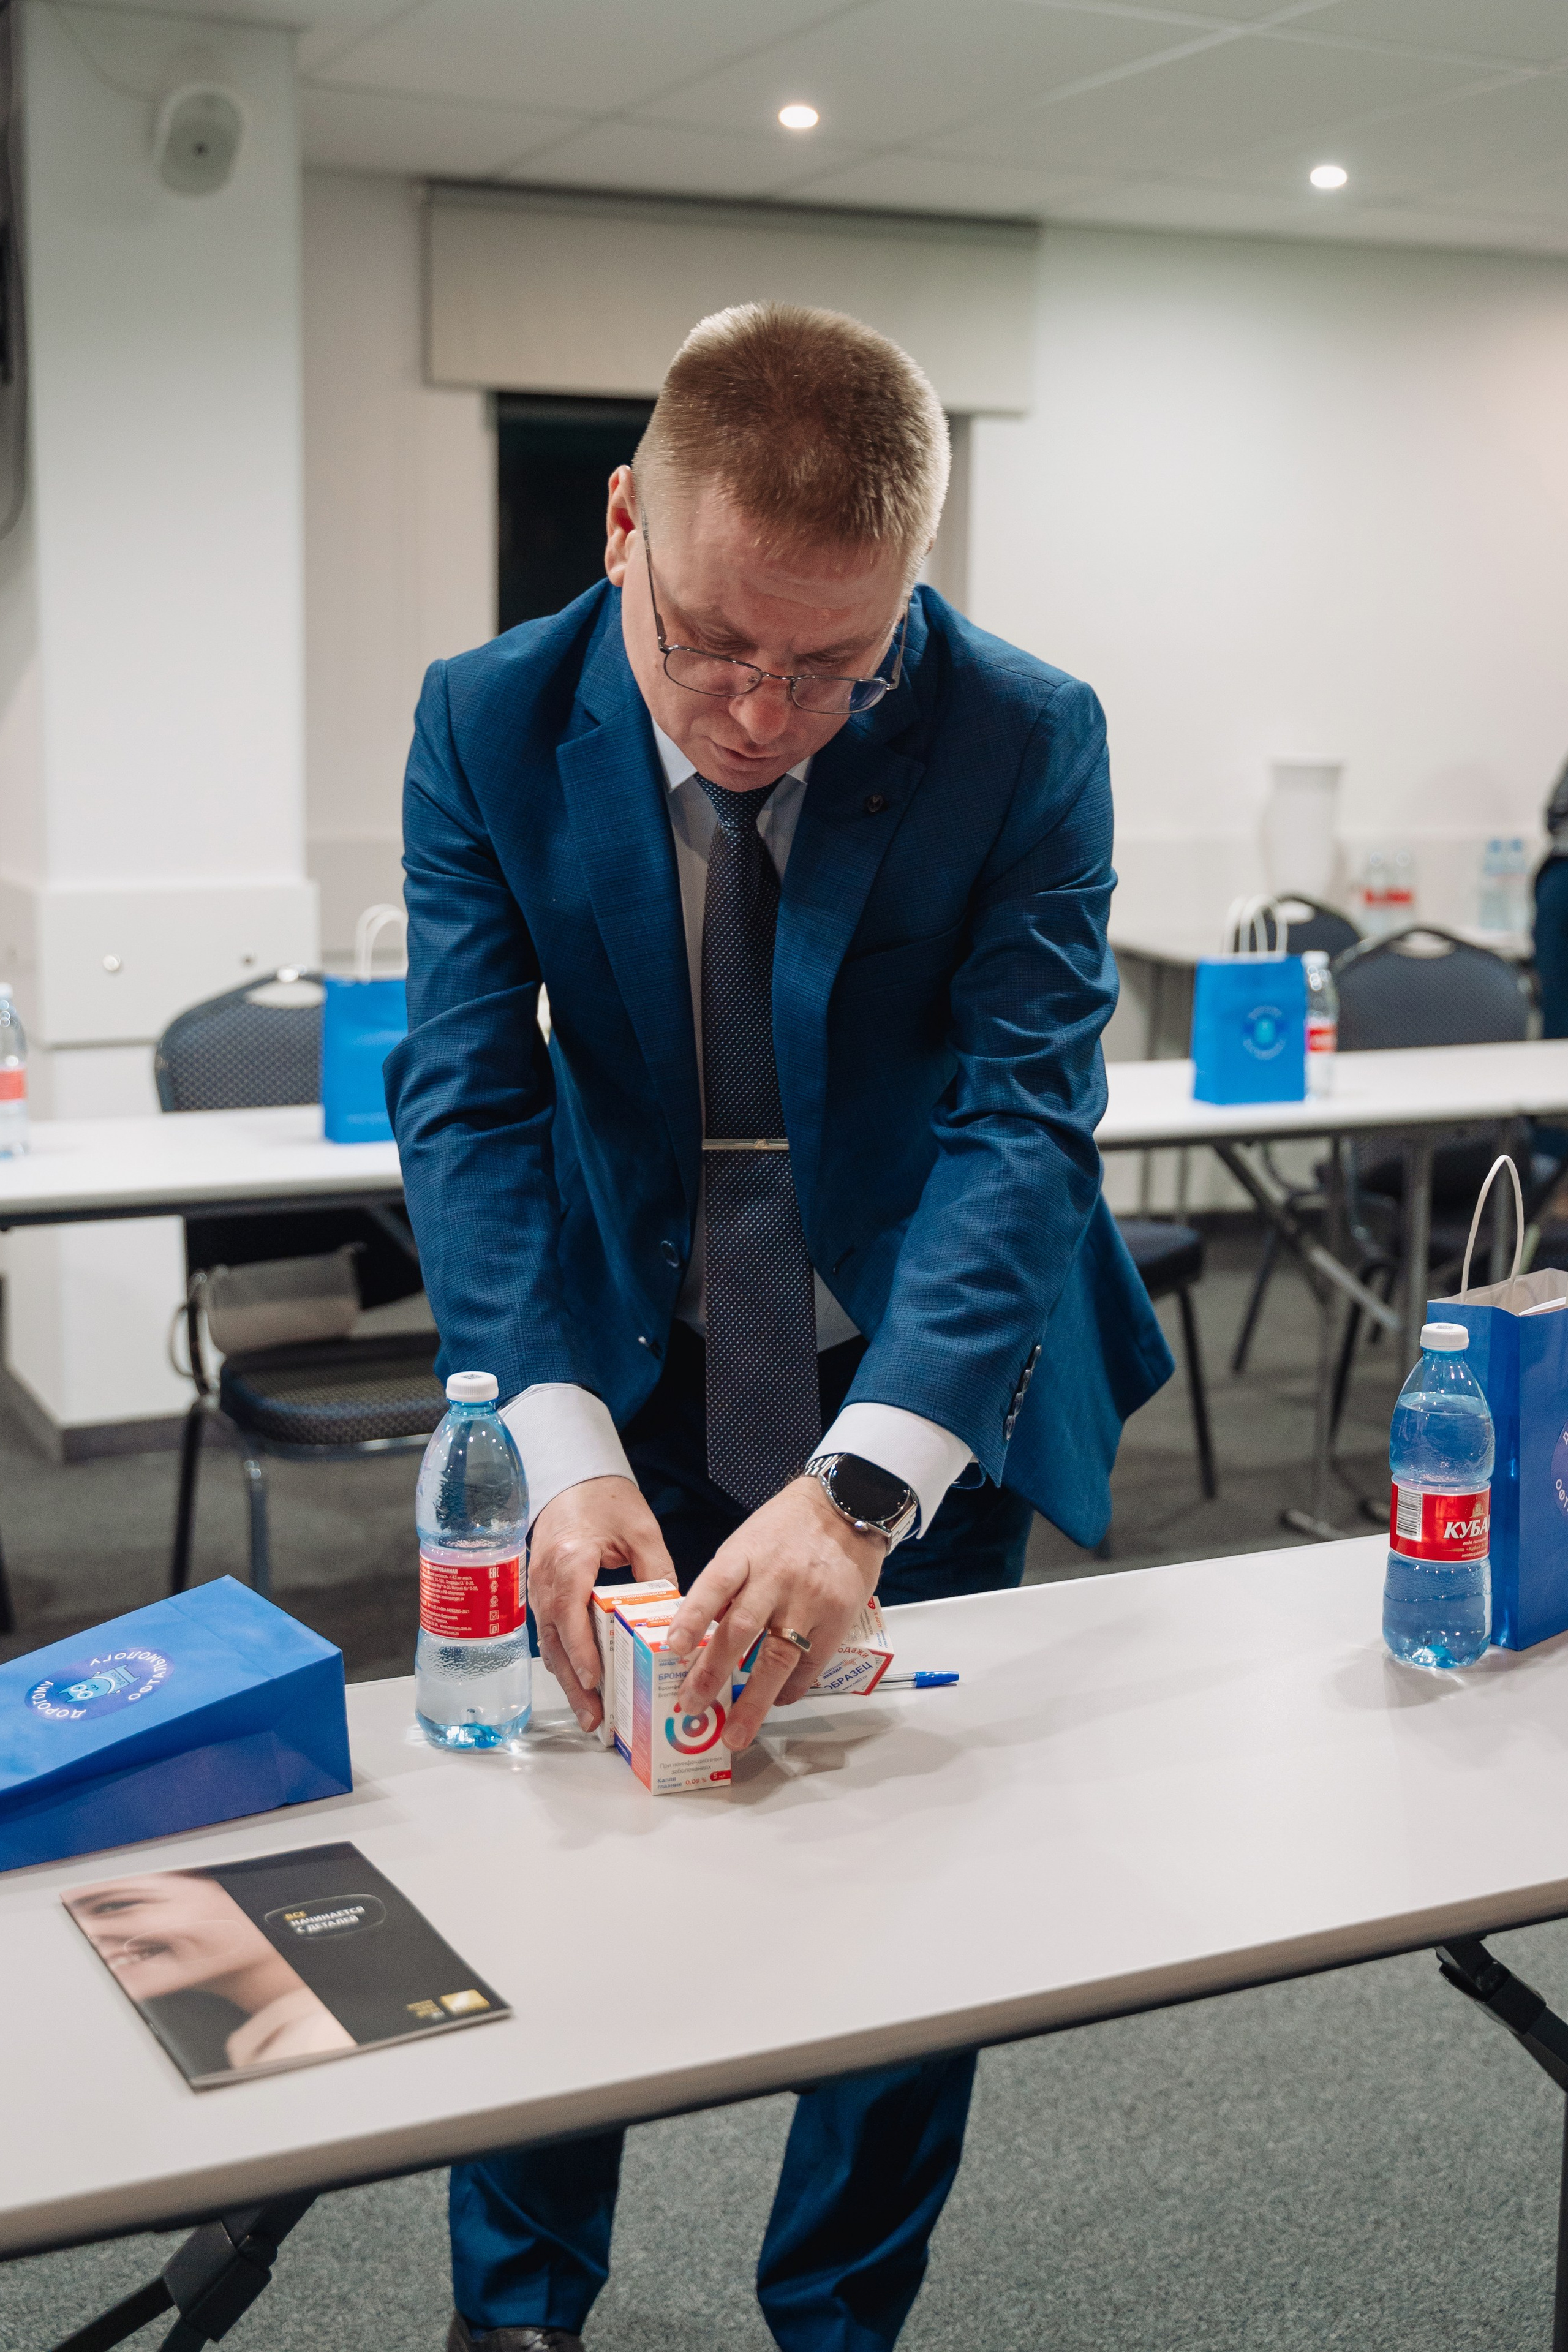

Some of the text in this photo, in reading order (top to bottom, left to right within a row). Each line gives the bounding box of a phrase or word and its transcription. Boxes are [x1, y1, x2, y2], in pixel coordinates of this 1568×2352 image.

[838, 1646, 869, 1659] одажи
[32, 1651, 167, 1719] ДОРОГОМУ ОФТАЛЬМОЛОГУ
[658, 1671, 688, 1681] БРОМФ
[290, 1905, 365, 1928] НАЧИНАЕТСЯ
[307, 1915, 360, 1936] ДЕТАЛЕЙ
